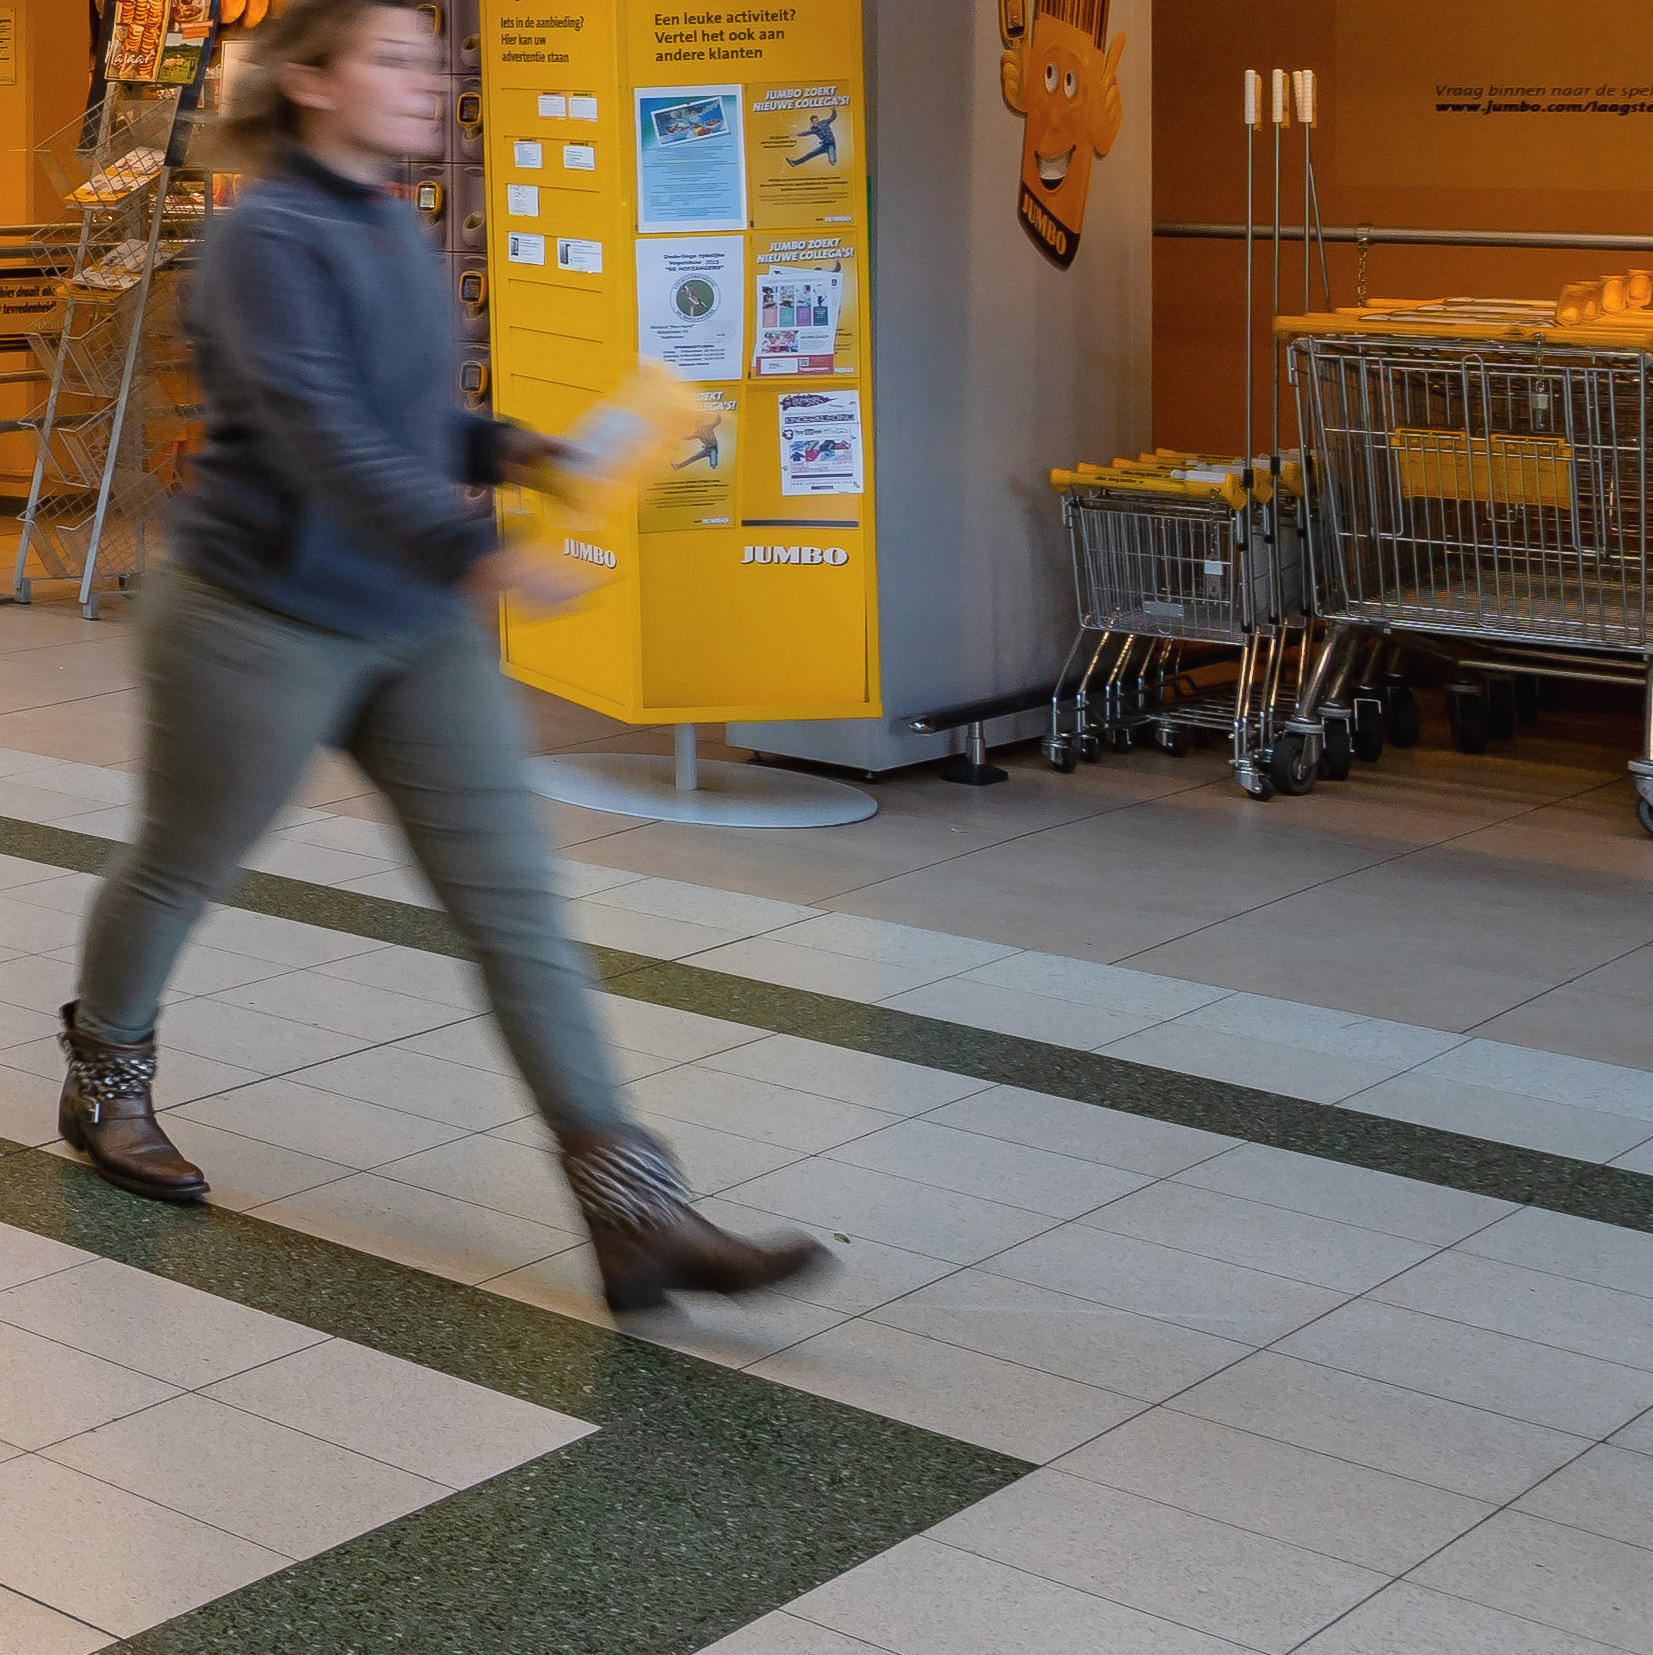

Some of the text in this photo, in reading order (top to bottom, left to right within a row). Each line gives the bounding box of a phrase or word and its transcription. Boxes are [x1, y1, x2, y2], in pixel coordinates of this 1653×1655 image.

[501, 16, 515, 29] Iets
[516, 16, 524, 29] in
[525, 16, 535, 29] de
[654, 9, 796, 25] Een leuke activiteit?
[501, 33, 547, 45] Hier kan uw
[655, 28, 785, 44] Vertel het ook aan
[547, 52, 569, 62] staan
[655, 47, 763, 62] andere klanten
[764, 86, 837, 100] JUMBO ZOEKT
[1435, 84, 1615, 99] Vraag binnen naar de
[753, 96, 850, 112] NIEUWE COLLEGA'S!
[1022, 193, 1067, 255] JUMBO
[769, 238, 841, 252] JUMBO ZOEKT
[756, 247, 854, 263] NIEUWE COLLEGA'S!
[0, 286, 15, 298] hier
[563, 537, 617, 570] JUMBO
[740, 545, 849, 566] JUMBO
